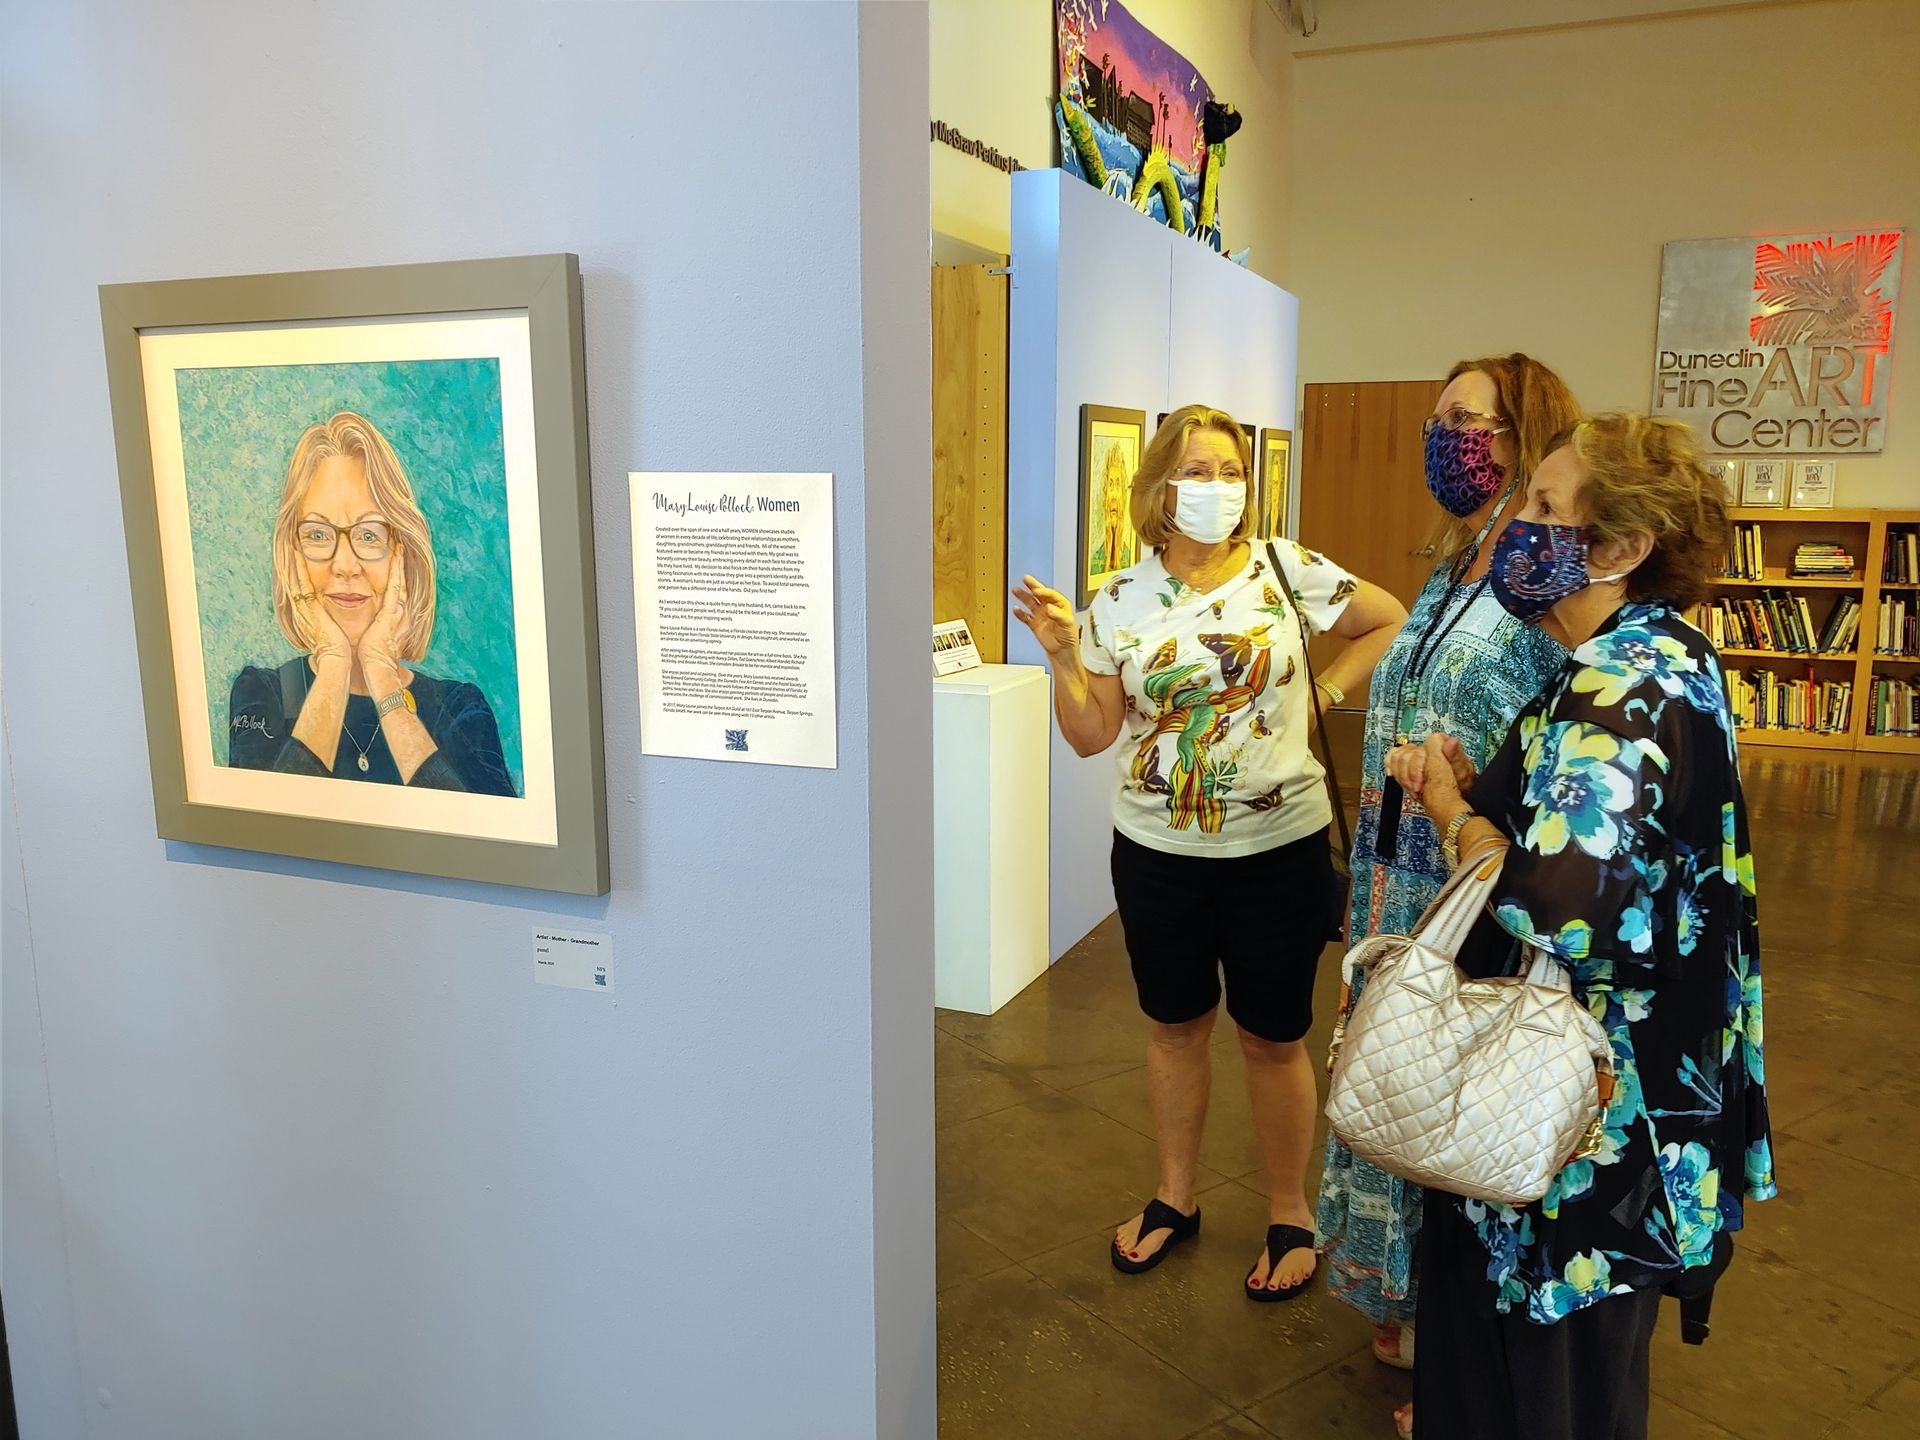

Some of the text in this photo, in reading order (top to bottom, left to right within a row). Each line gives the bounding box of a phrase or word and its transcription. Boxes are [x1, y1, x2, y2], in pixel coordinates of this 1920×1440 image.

[976, 140, 1008, 172] Perkins
[1659, 349, 1764, 369] Dunedin
[1656, 345, 1888, 408] Fine ART
[1711, 409, 1880, 448] Center
[652, 492, 686, 517] Mary
[687, 492, 718, 514] Louise
[757, 497, 800, 512] Women
